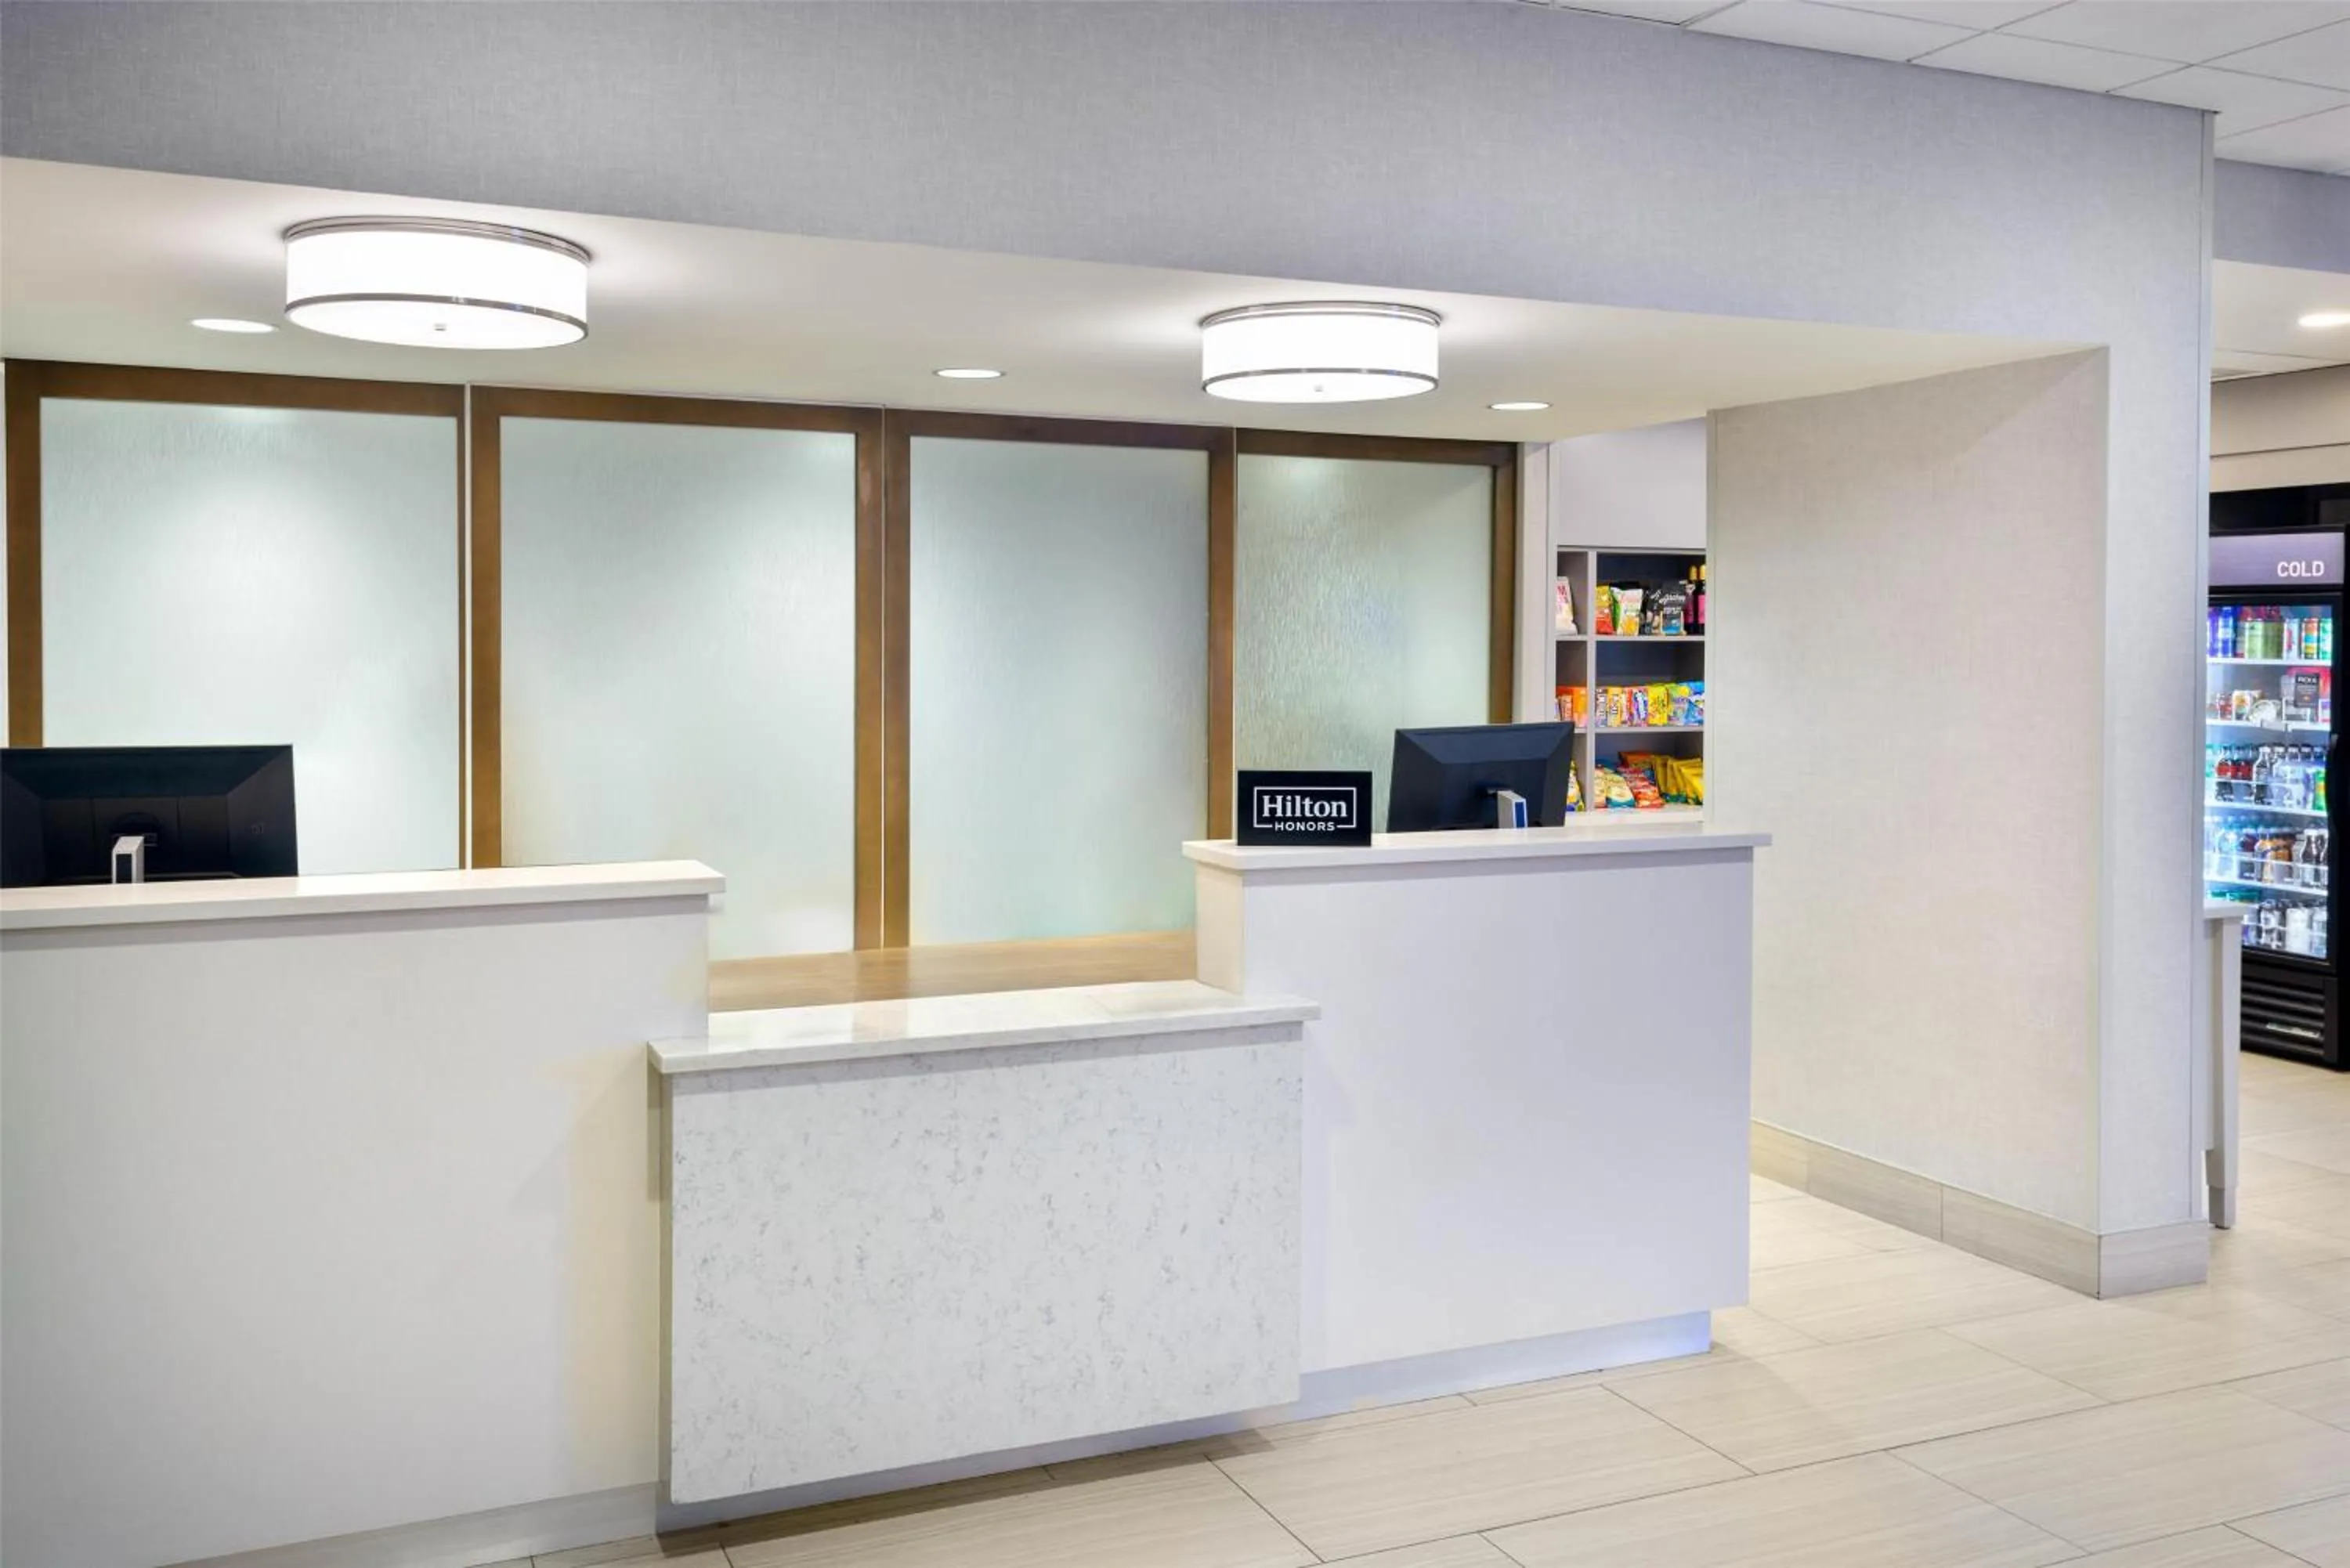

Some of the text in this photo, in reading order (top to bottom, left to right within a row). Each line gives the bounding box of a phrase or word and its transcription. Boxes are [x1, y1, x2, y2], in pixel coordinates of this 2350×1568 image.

[2276, 560, 2325, 577] COLD
[1262, 794, 1348, 818] Hilton
[1274, 821, 1336, 832] HONORS
